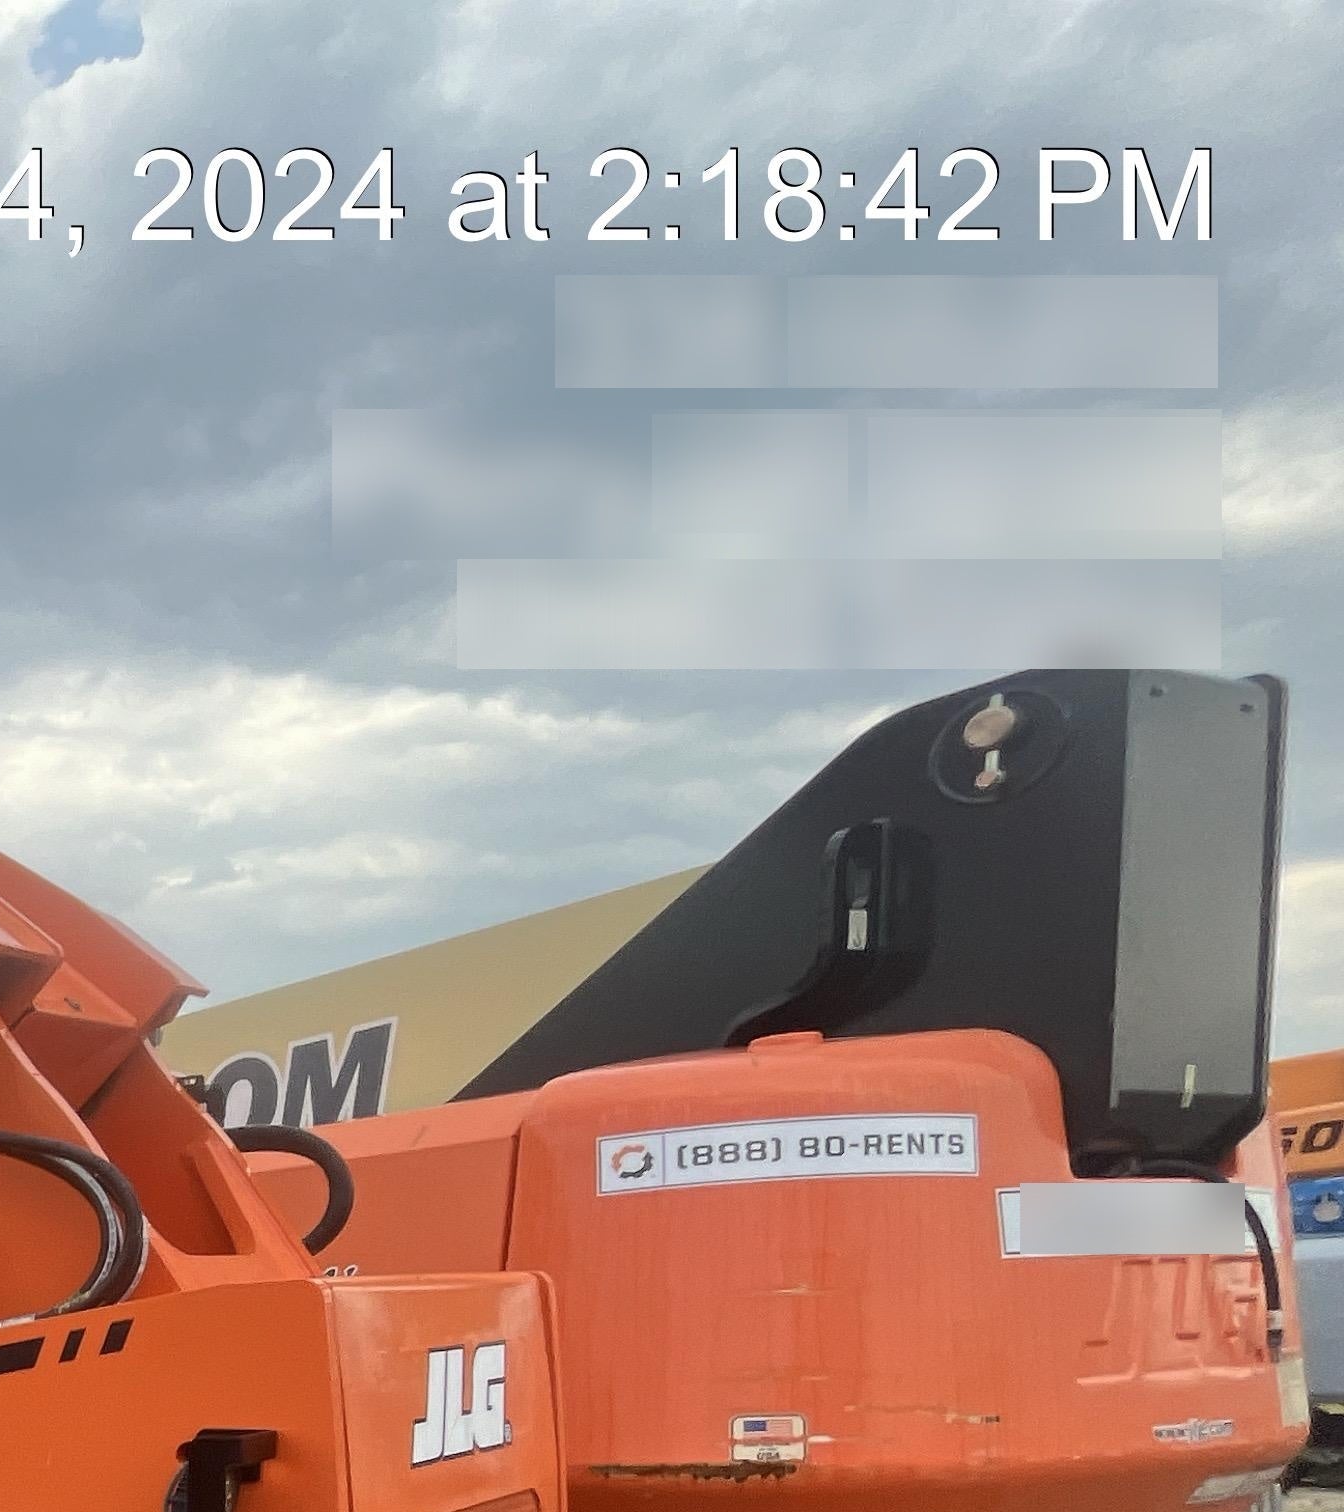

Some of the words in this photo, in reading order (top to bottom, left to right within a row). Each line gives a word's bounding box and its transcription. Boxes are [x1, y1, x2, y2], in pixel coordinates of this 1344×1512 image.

[675, 1136, 783, 1171] (888)
[797, 1132, 966, 1160] 80-RENTS
[410, 1340, 511, 1469] JLG
